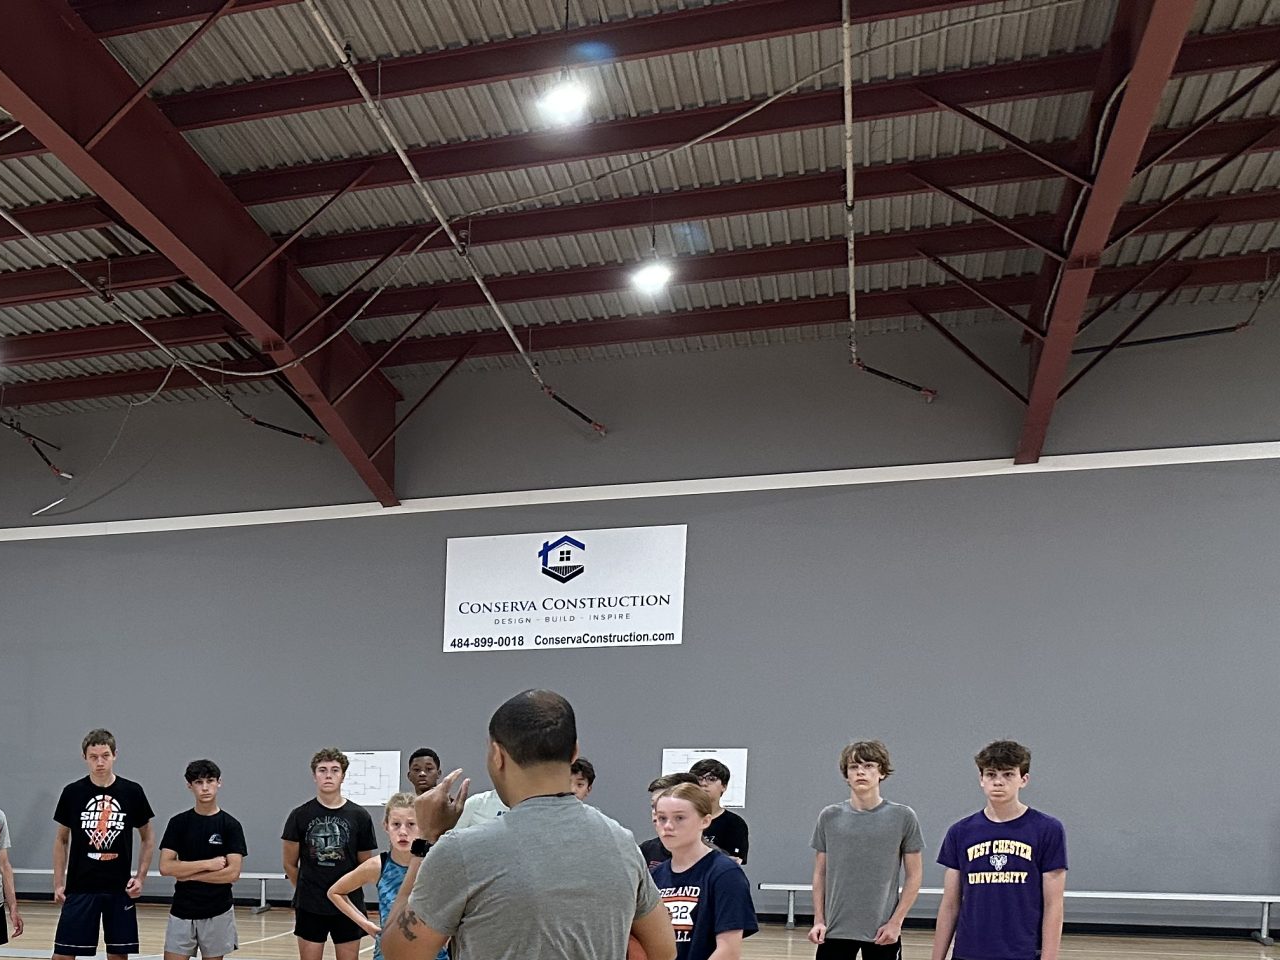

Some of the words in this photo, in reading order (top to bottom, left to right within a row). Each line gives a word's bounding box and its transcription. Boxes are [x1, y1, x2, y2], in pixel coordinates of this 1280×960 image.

[458, 600, 537, 615] CONSERVA
[542, 594, 671, 611] CONSTRUCTION
[494, 617, 532, 625] DESIGN
[545, 615, 576, 623] BUILD
[589, 613, 631, 621] INSPIRE
[450, 635, 524, 649] 484-899-0018
[534, 631, 675, 646] ConservaConstruction.com
[967, 841, 992, 862] WEST
[992, 840, 1032, 861] CHESTER
[968, 871, 1028, 884] UNIVERSITY
